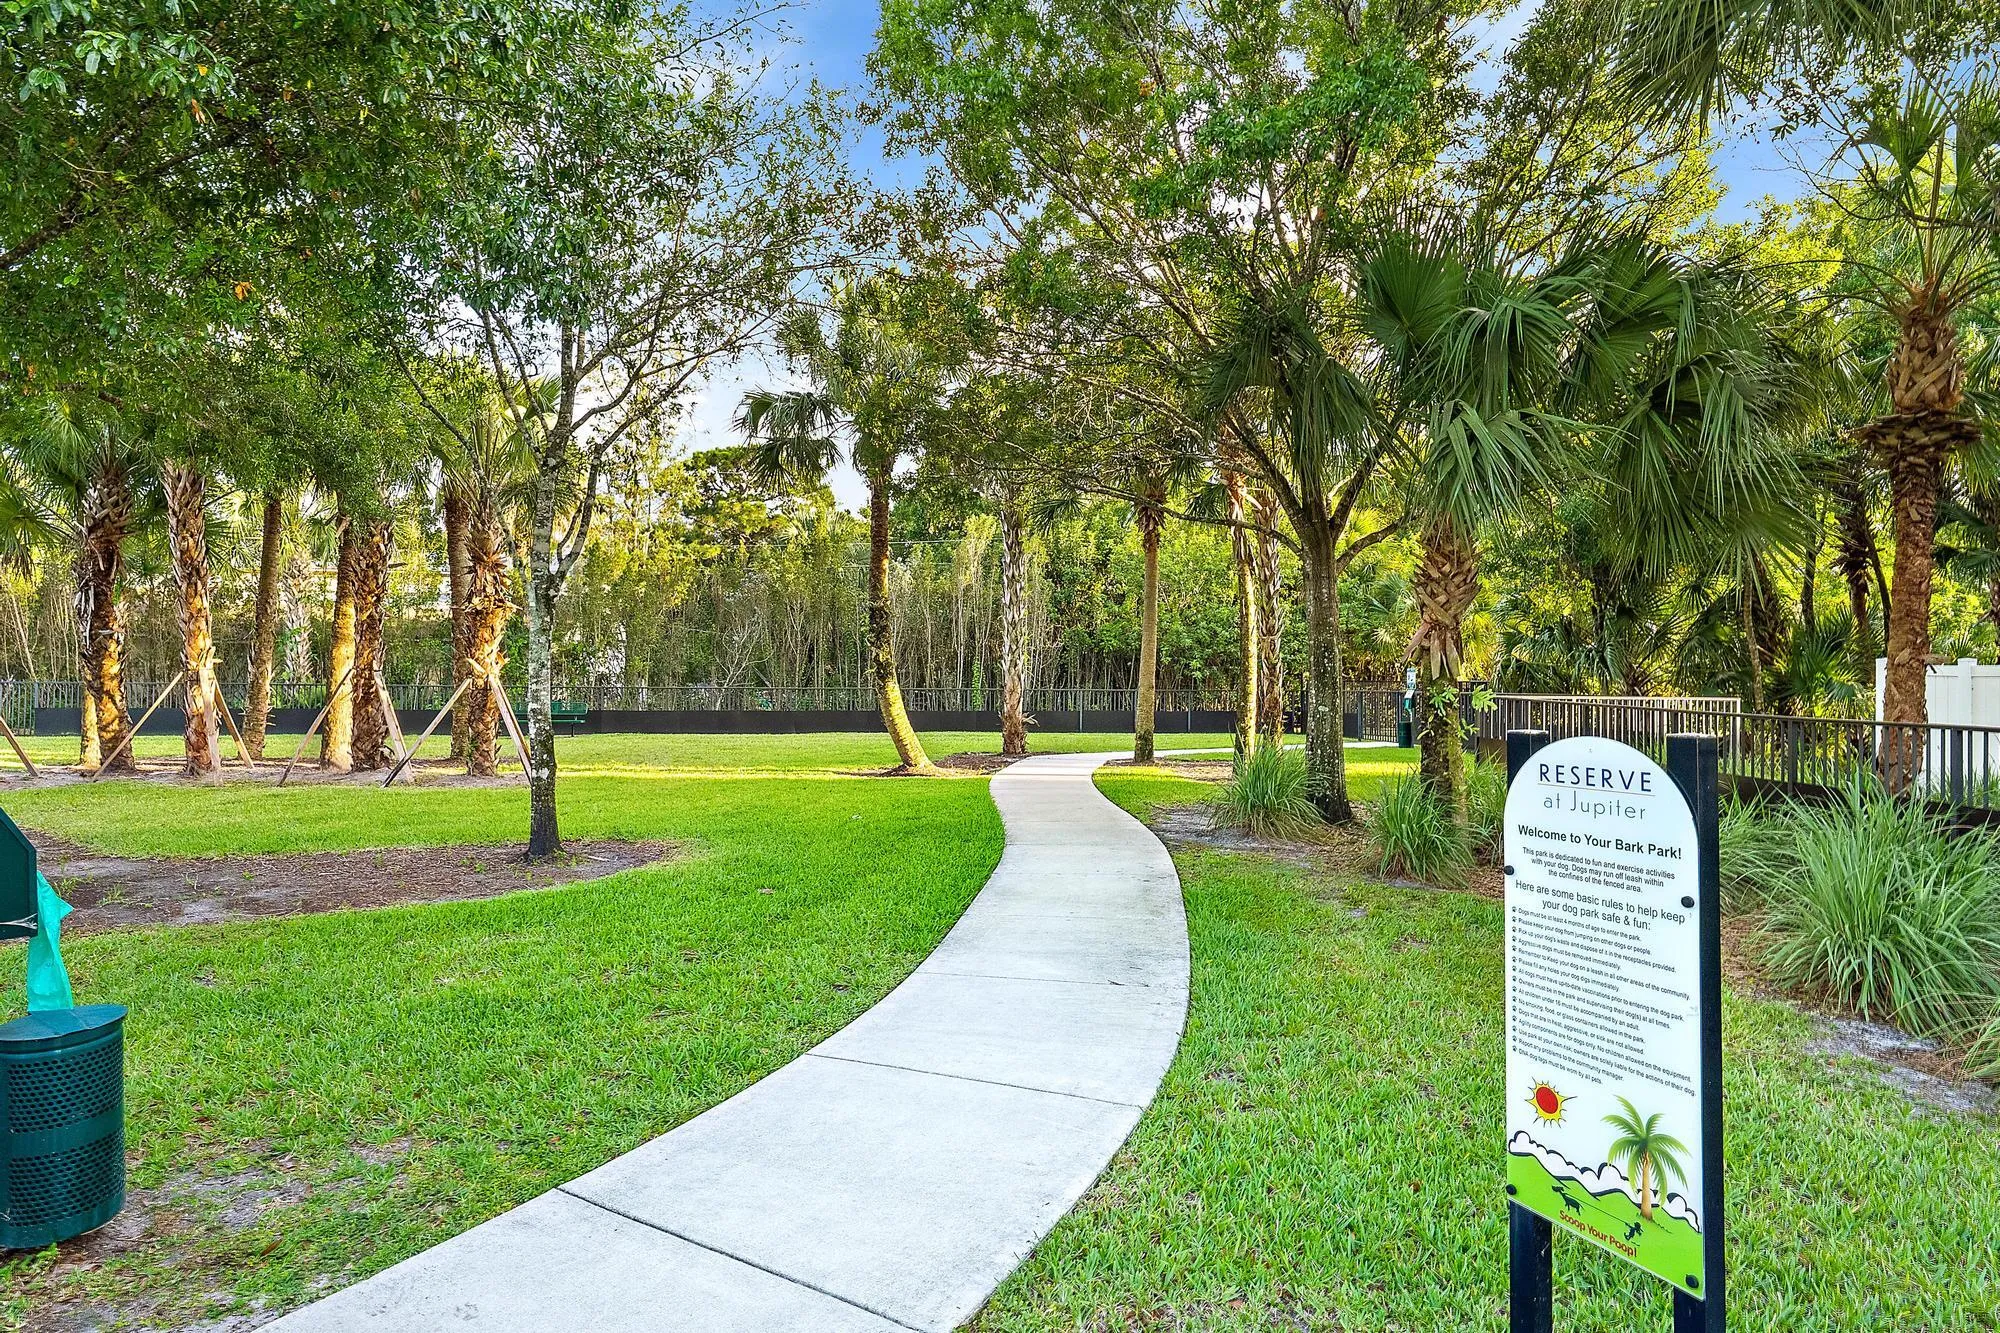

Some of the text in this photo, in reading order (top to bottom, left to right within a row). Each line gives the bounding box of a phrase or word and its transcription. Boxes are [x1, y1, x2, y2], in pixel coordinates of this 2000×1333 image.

[1539, 763, 1652, 793] RESERVE
[1543, 790, 1646, 820] at Jupiter
[1517, 824, 1682, 860] Welcome to Your Bark Park!
[1522, 846, 1676, 880] This park is dedicated to fun and exercise activities
[1530, 857, 1664, 888] with your dog. Dogs may run off leash within
[1548, 868, 1643, 894] the confines of the fenced area.
[1515, 879, 1686, 926] Here are some basic rules to help keep
[1542, 899, 1651, 931] your dog park safe & fun:
[1559, 1210, 1637, 1258] Scoop Your Poop!
